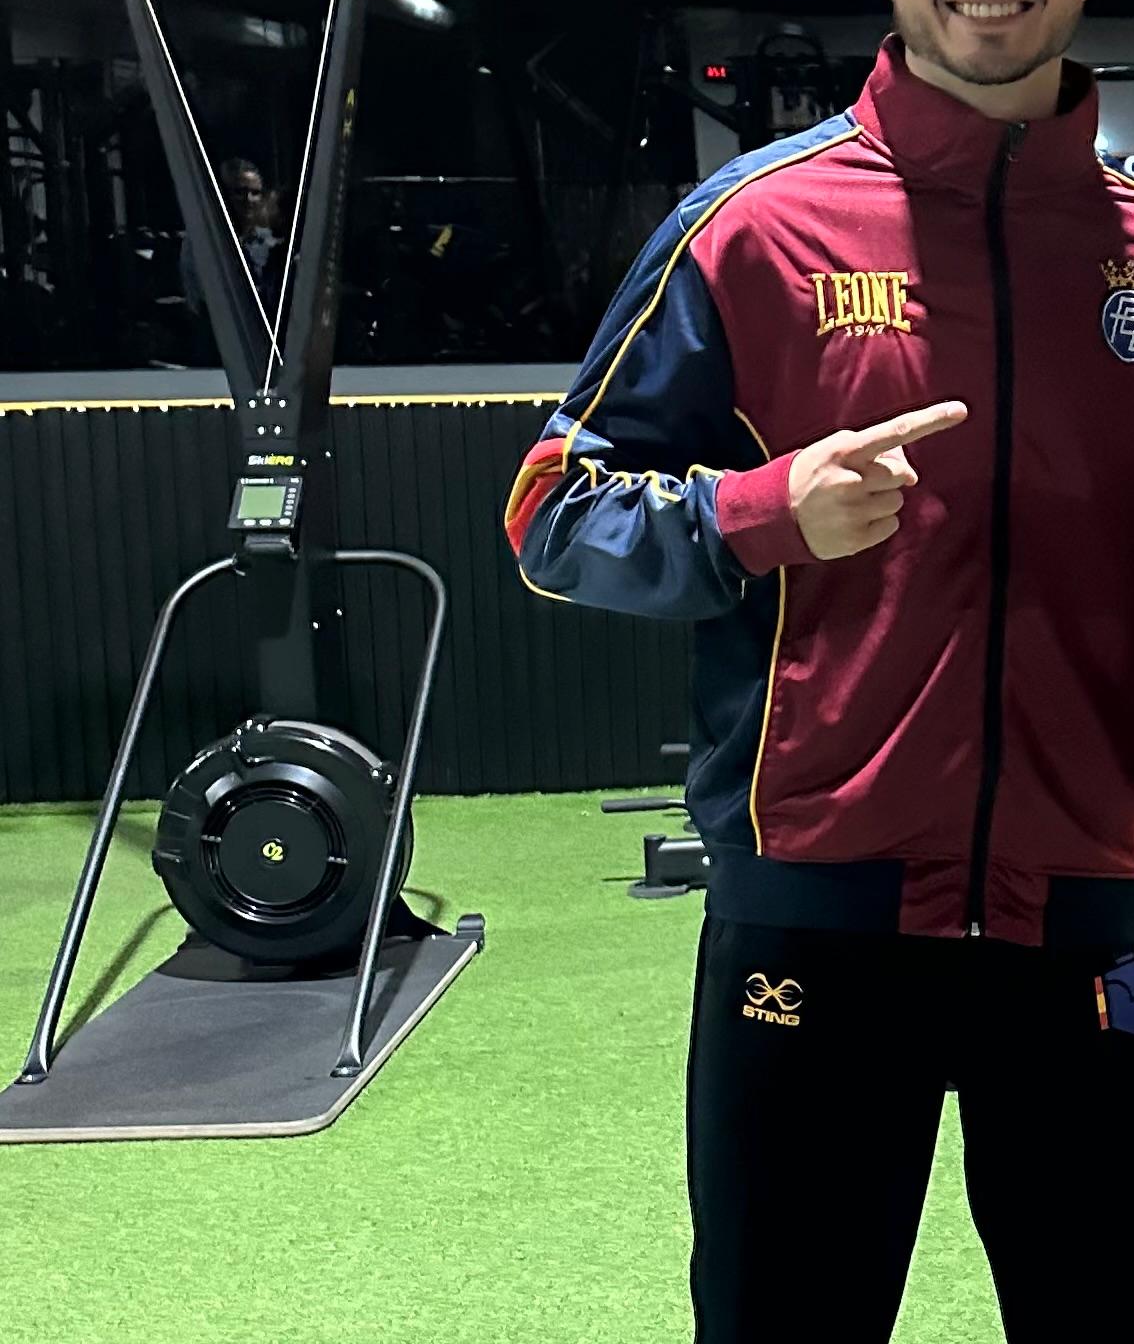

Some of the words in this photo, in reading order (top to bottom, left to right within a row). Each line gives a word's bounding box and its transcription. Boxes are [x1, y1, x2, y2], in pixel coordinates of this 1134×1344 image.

[811, 271, 912, 337] LEONE
[262, 842, 284, 861] C2
[743, 1004, 801, 1026] STING
